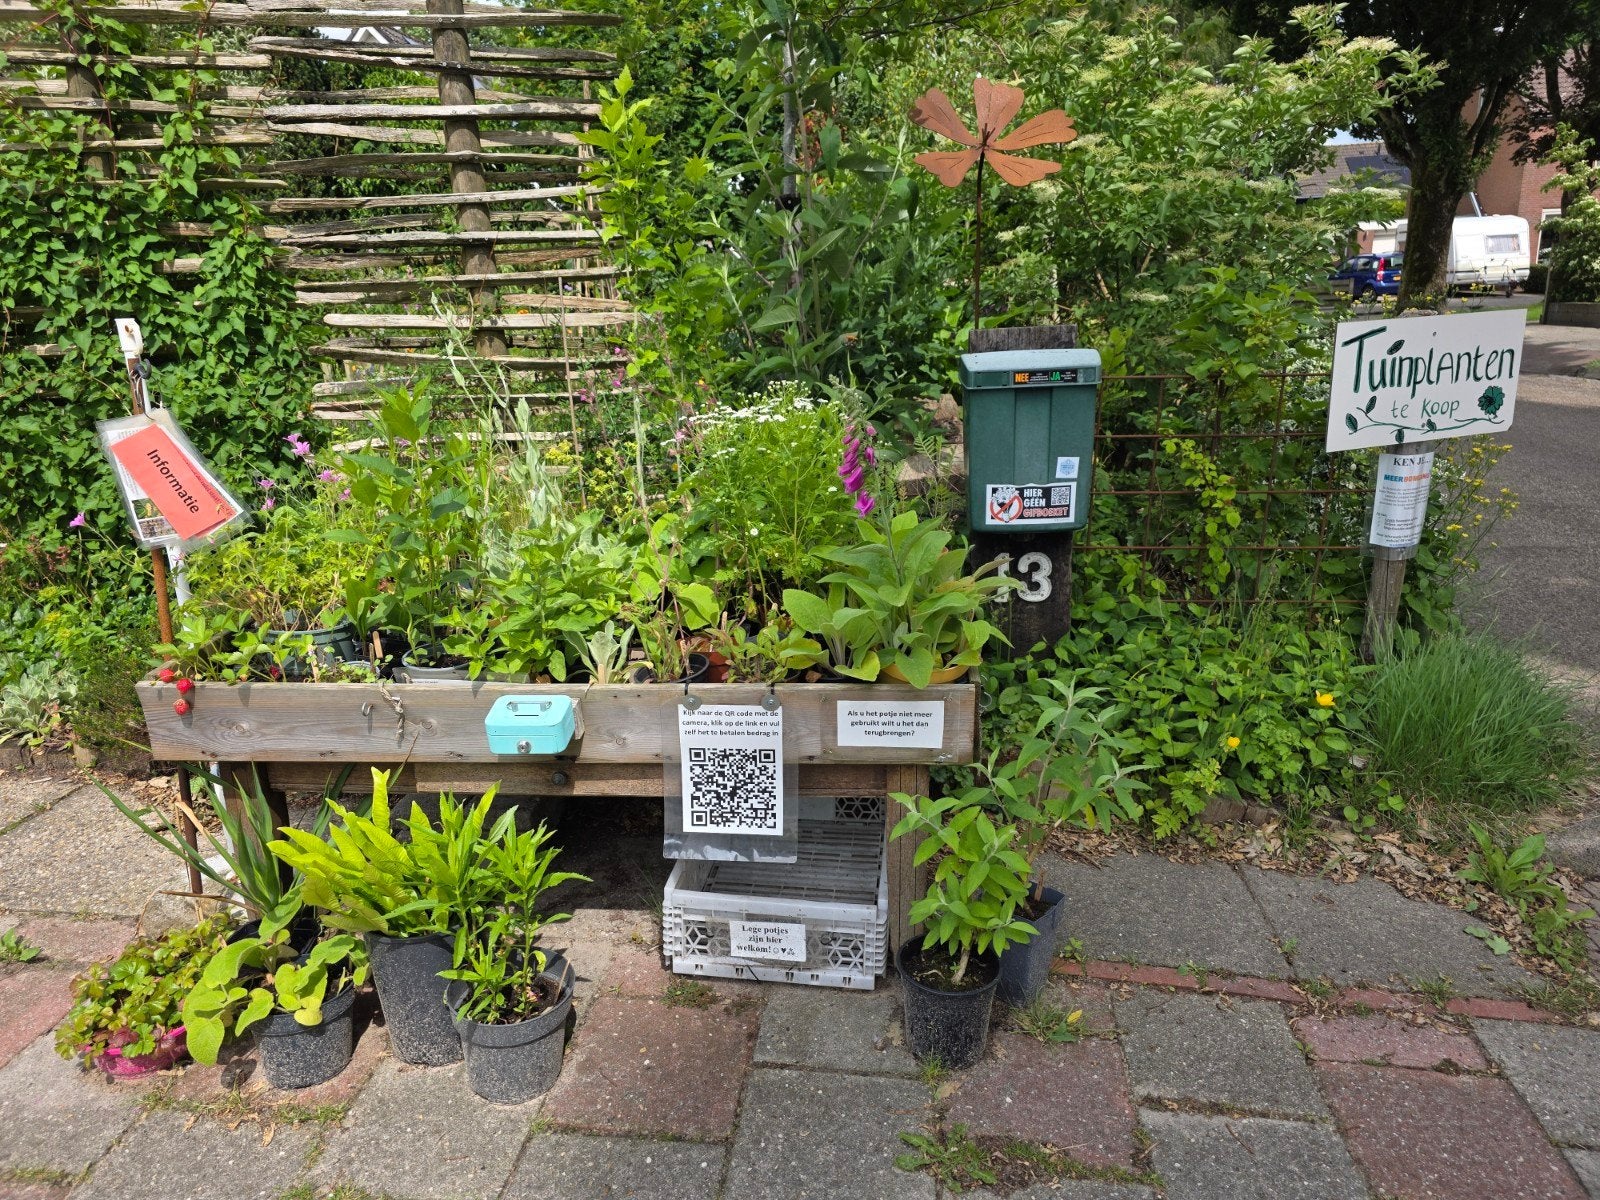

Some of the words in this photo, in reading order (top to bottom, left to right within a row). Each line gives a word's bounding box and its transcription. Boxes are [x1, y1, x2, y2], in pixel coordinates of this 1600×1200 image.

[1015, 373, 1029, 382] NEE
[1051, 372, 1060, 380] JA
[1391, 401, 1409, 418] te
[1394, 458, 1415, 466] KEN
[147, 449, 199, 514] Informatie
[1024, 489, 1042, 497] HIER
[994, 552, 1052, 602] 13
[683, 709, 695, 717] Kijk
[742, 925, 762, 934] Lege
[764, 926, 789, 935] potjes
[748, 935, 764, 943] zijn
[737, 944, 771, 953] welkom!
